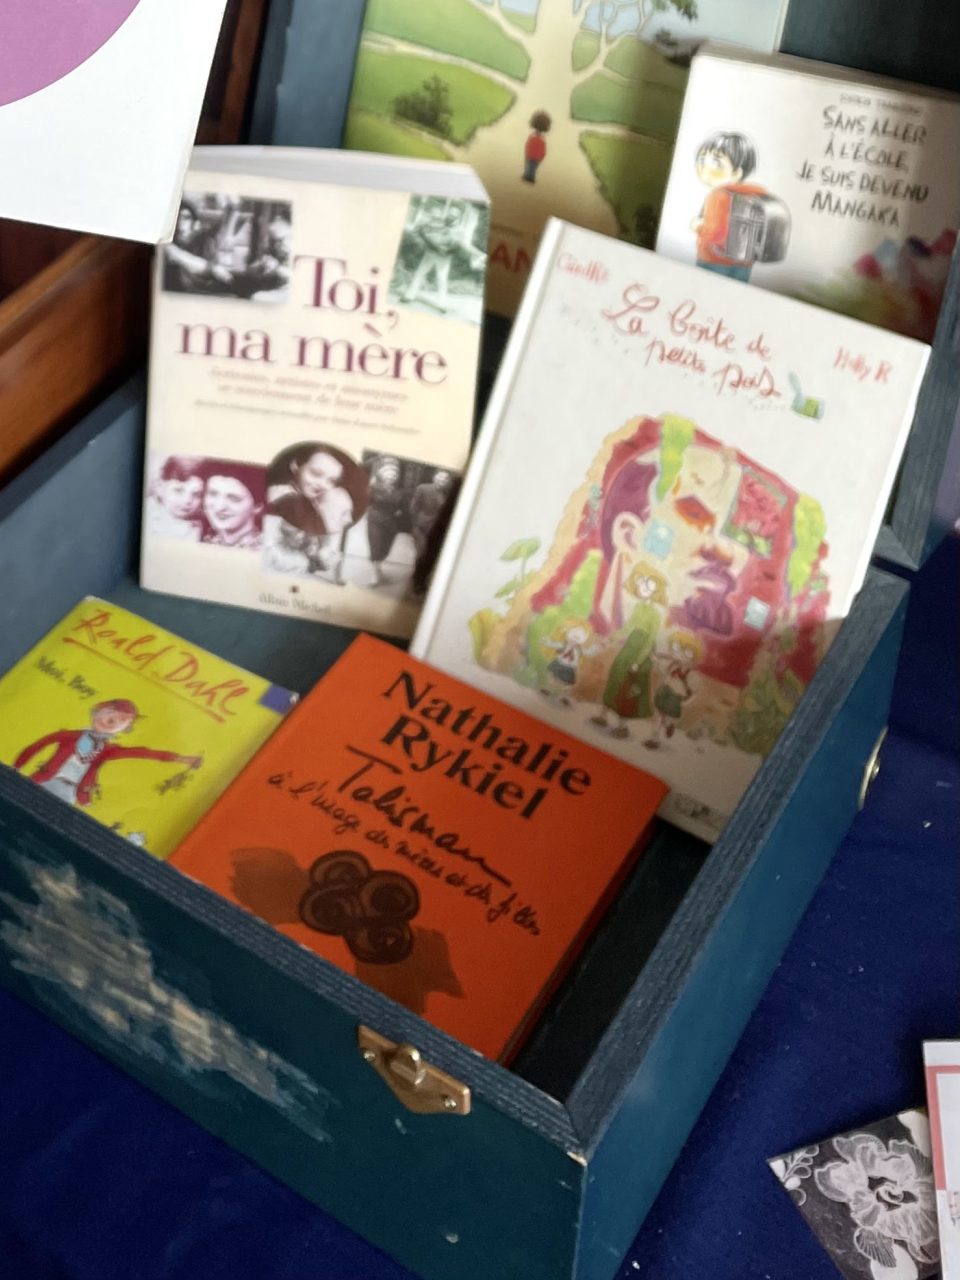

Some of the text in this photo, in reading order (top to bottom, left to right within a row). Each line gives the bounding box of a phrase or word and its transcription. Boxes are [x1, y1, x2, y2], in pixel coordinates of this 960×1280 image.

[822, 105, 928, 145] SANS ALLER
[795, 158, 930, 205] JE SUIS DEVENU
[809, 189, 901, 229] MANGAKA
[291, 254, 401, 327] Toi,
[601, 281, 661, 338] La
[746, 332, 774, 362] de
[175, 321, 449, 386] ma mère
[74, 608, 250, 716] Roald Dahl
[379, 714, 547, 821] Rykiel
[382, 670, 592, 797] Nathalie
[337, 744, 513, 889] Talisman
